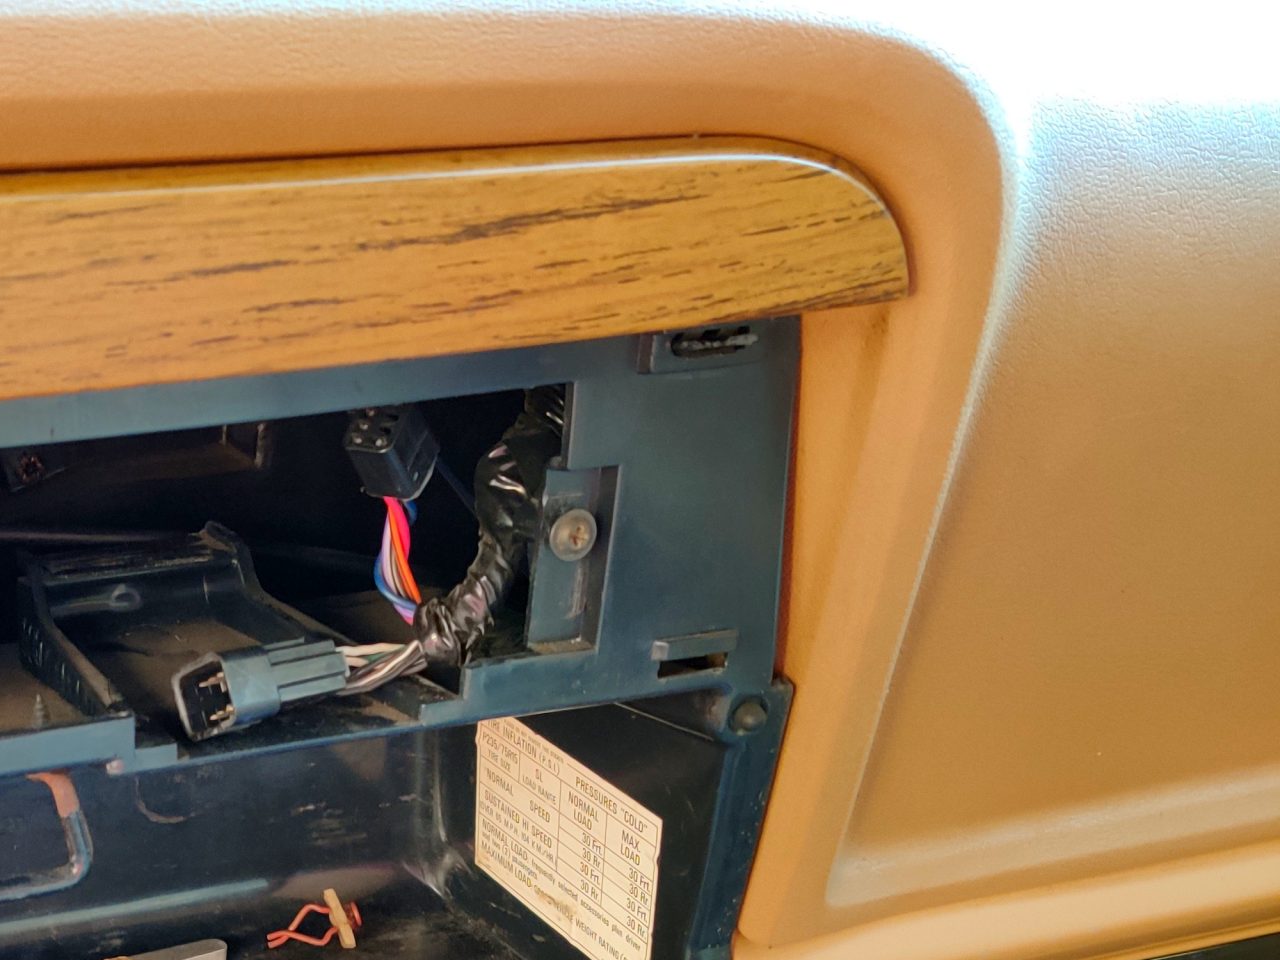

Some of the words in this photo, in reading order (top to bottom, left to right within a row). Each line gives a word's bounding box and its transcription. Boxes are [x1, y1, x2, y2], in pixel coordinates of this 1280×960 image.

[502, 728, 536, 758] INFLATION
[575, 777, 617, 813] PRESSURES
[620, 807, 648, 833] "COLD"
[529, 800, 550, 823] SPEED
[567, 792, 599, 822] NORMAL
[484, 790, 519, 824] SUSTAINED
[522, 819, 529, 831] HI
[531, 826, 552, 849] SPEED
[573, 809, 592, 831] LOAD
[581, 833, 590, 846] 30
[582, 848, 590, 861] 30
[619, 843, 640, 866] LOAD
[579, 862, 588, 876] 30
[628, 868, 638, 882] 30
[482, 819, 509, 847] NORMAL
[625, 934, 640, 952] driver
[580, 880, 588, 893] 30
[629, 883, 638, 897] 30
[481, 841, 513, 874] MAXIMUM
[575, 918, 597, 942] WEIGHT
[598, 937, 619, 960] RATING
[626, 898, 636, 913] 30
[626, 917, 635, 930] 30
